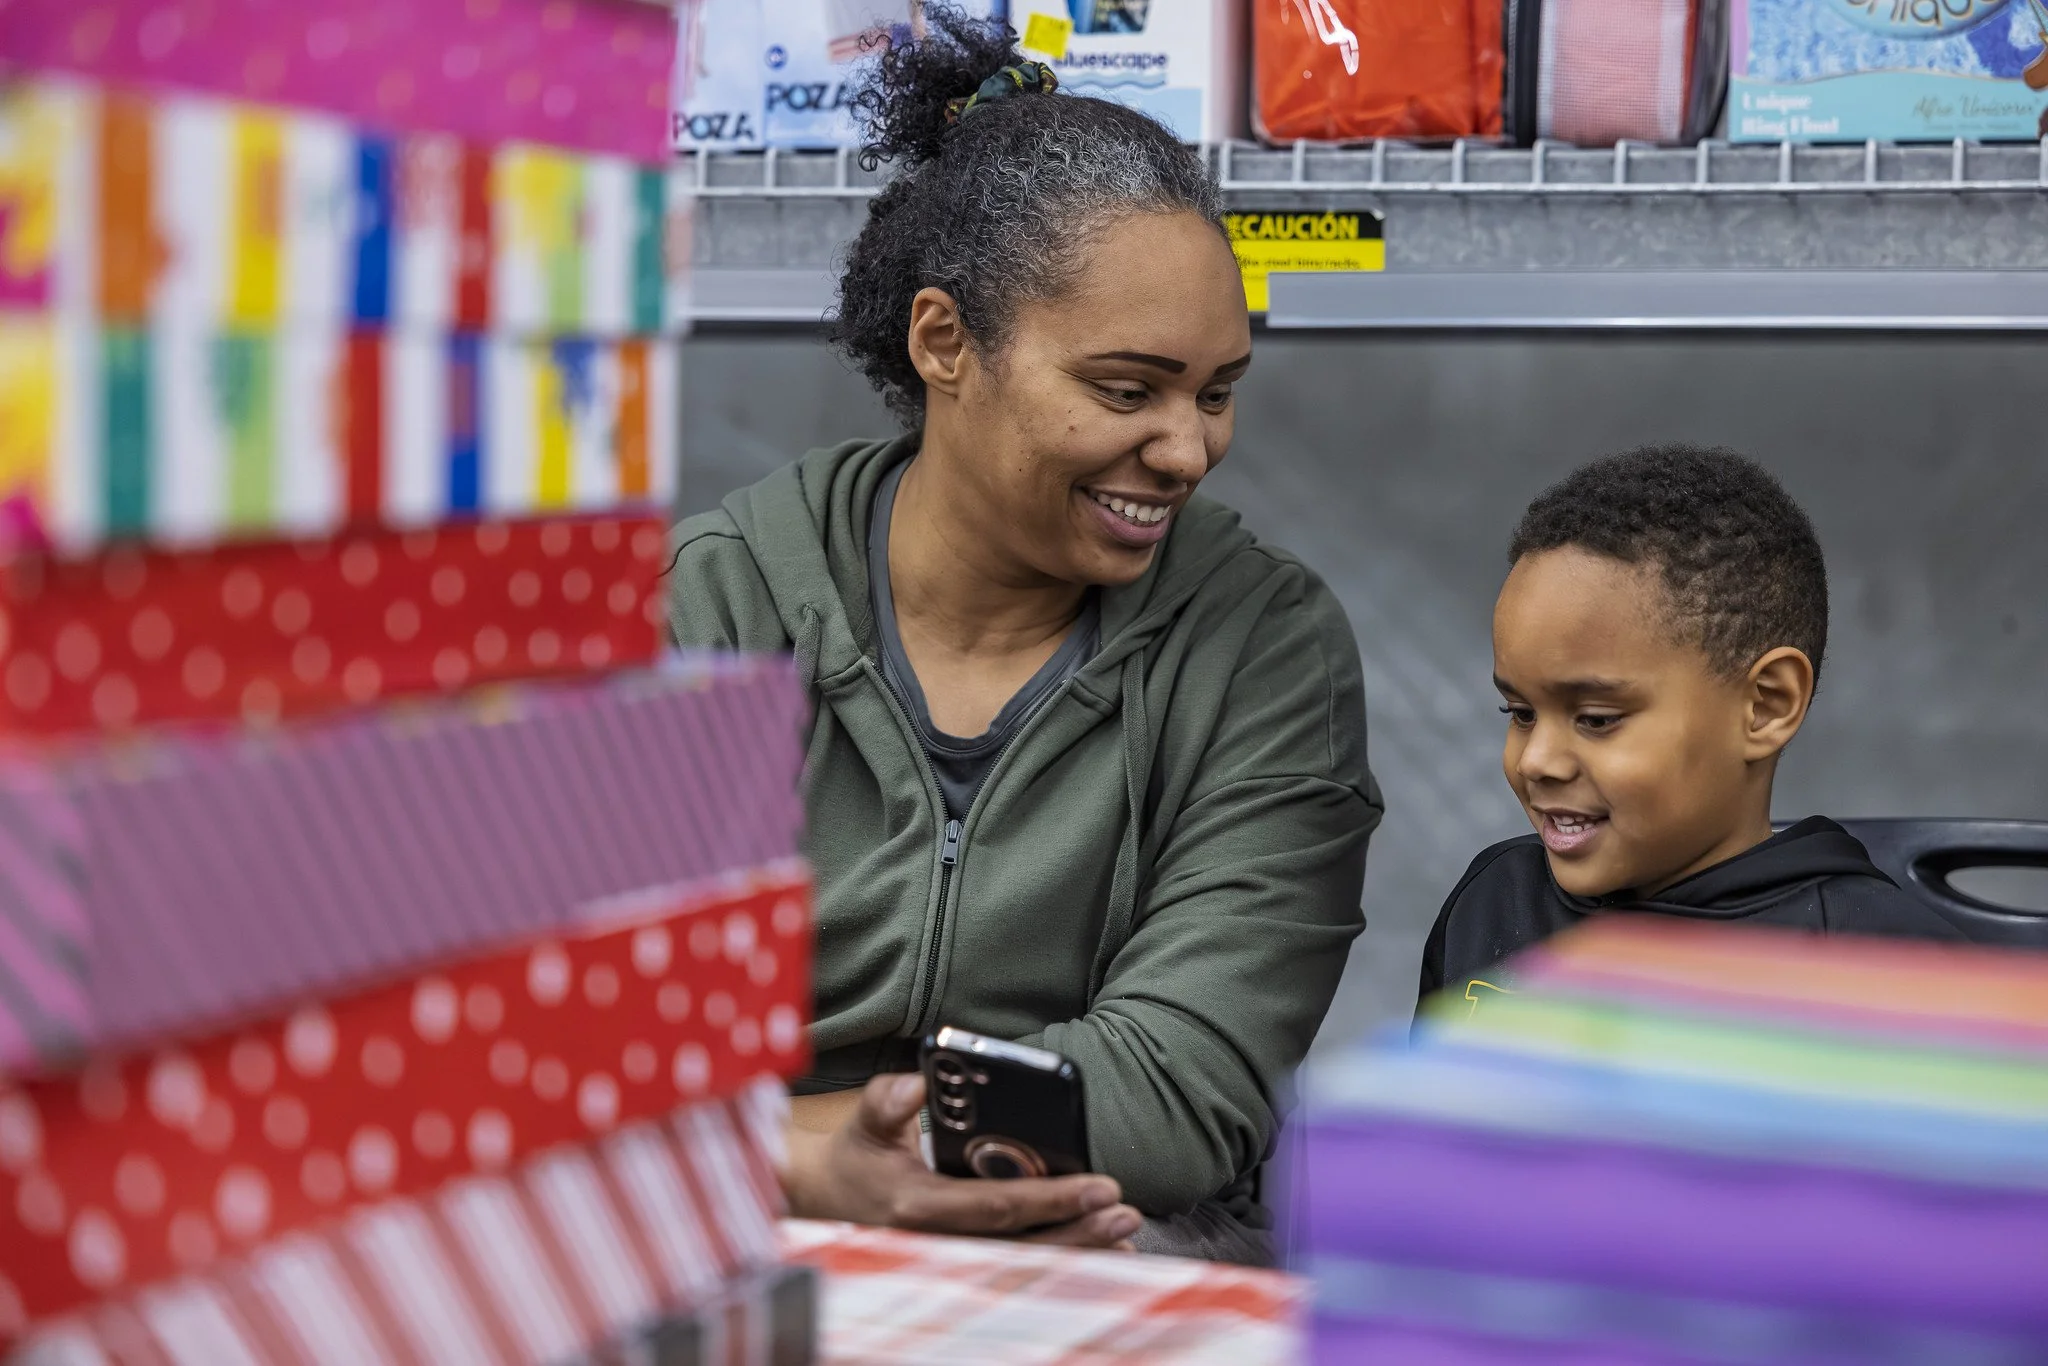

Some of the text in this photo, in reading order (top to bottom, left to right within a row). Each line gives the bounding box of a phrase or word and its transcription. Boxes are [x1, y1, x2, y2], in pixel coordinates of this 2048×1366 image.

[765, 82, 857, 111] POZA
[671, 112, 756, 140] POZA
[1224, 211, 1359, 240] ECAUCIÓN
